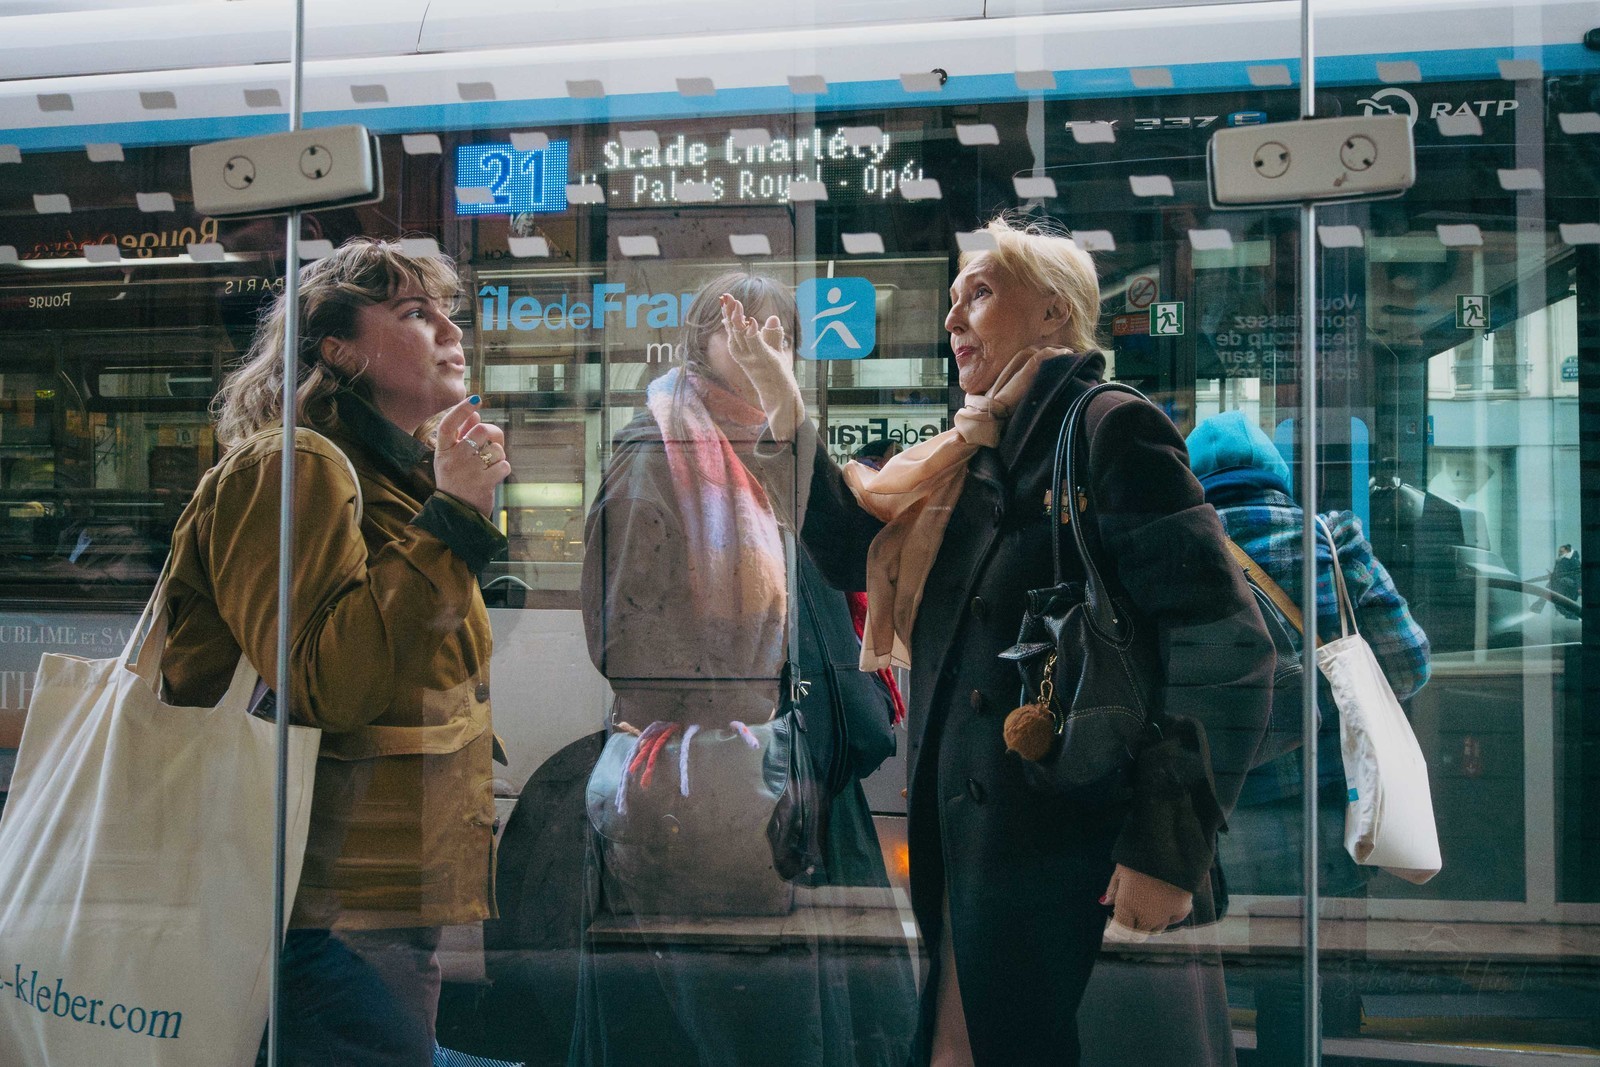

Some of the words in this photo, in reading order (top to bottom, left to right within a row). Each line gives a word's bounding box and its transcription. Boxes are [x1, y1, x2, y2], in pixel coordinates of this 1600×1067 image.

[1430, 100, 1519, 119] RATP
[479, 149, 546, 207] 21
[633, 169, 724, 202] Palis
[740, 164, 821, 203] Royl
[0, 964, 183, 1039] -kleber.com
